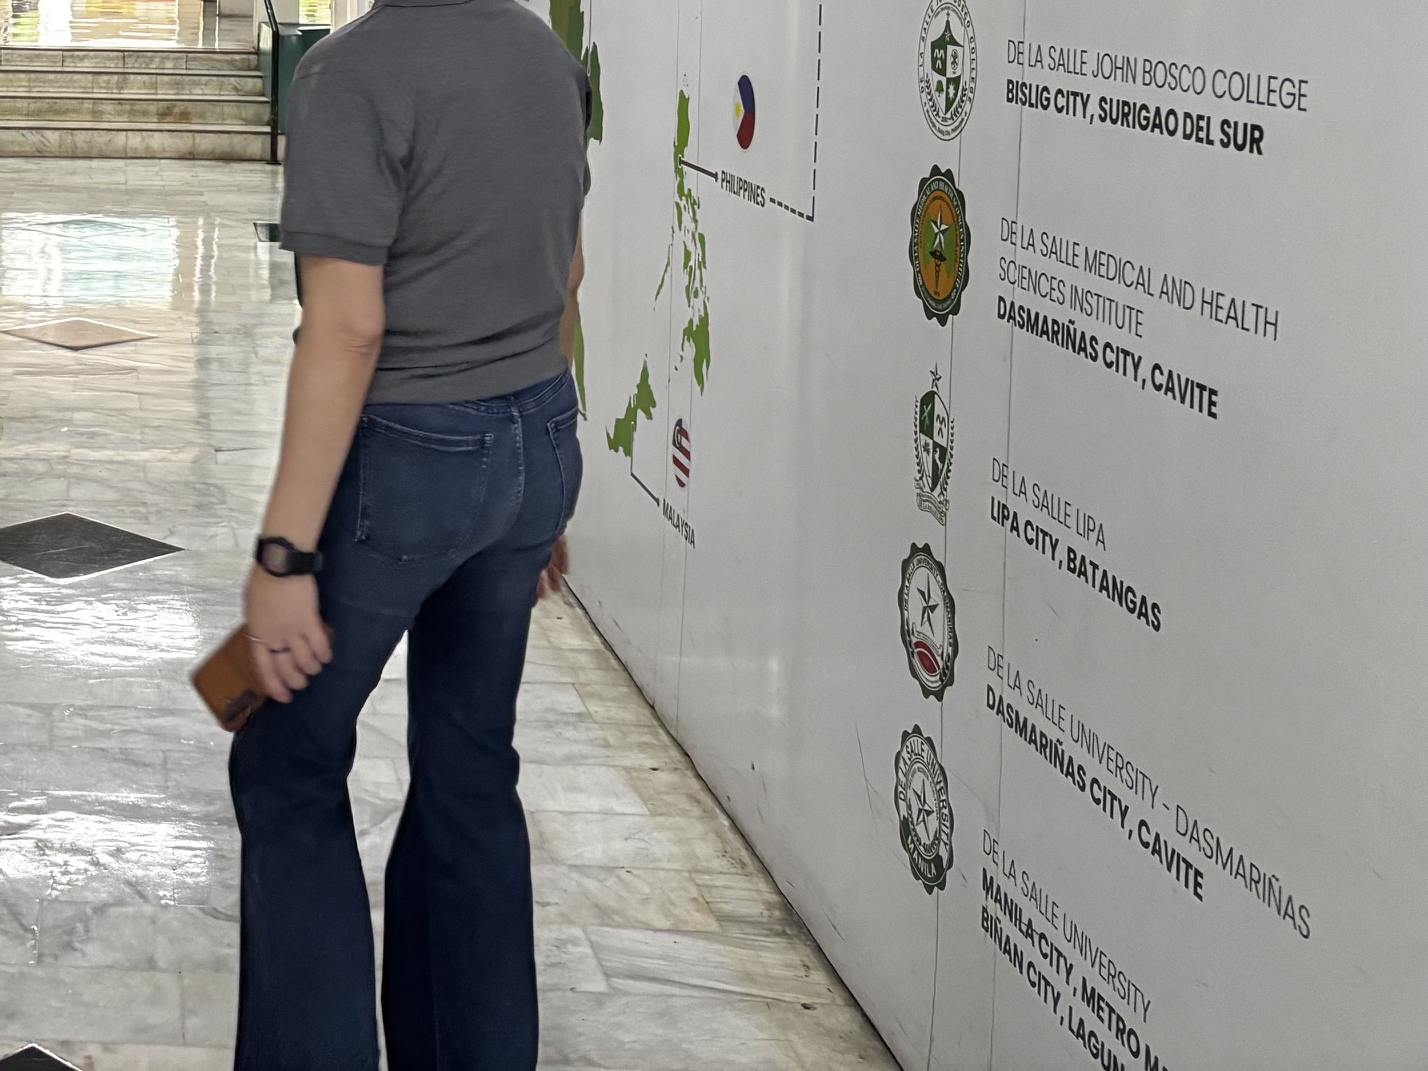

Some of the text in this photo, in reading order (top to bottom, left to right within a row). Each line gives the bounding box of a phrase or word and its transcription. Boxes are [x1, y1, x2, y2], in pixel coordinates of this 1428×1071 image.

[1006, 79, 1264, 156] BISLIG CITY, SURIGAO DEL SUR
[1007, 39, 1308, 111] DE LA SALLE JOHN BOSCO COLLEGE
[721, 170, 766, 208] PHILIPPINES
[999, 257, 1144, 338] SCIENCES INSTITUTE
[1001, 218, 1279, 341] DE LA SALLE MEDICAL AND HEALTH
[998, 295, 1218, 419] DASMARIÑAS CITY, CAVITE
[663, 498, 695, 549] MALAYSIA
[991, 496, 1020, 538] LIPA
[1024, 520, 1062, 570] CITY,
[1067, 545, 1161, 632] BATANGAS
[992, 457, 1106, 551] DE LA SALLE LIPA
[987, 645, 1003, 680] DE
[1007, 663, 1022, 697] LA
[1027, 680, 1065, 732] SALLE
[1071, 714, 1158, 809] UNIVERSITY
[1176, 805, 1310, 939] DASMARIÑAS
[987, 684, 1203, 902] DASMARIÑAS CITY, CAVITE
[982, 867, 1035, 947] MANILA
[1038, 932, 1077, 997] CITY,
[1082, 976, 1140, 1059] METRO
[982, 905, 1023, 975] BIÑAN
[1027, 961, 1064, 1026] CITY,
[983, 829, 1150, 1023] DE LA SALLE UNIVERSITY
